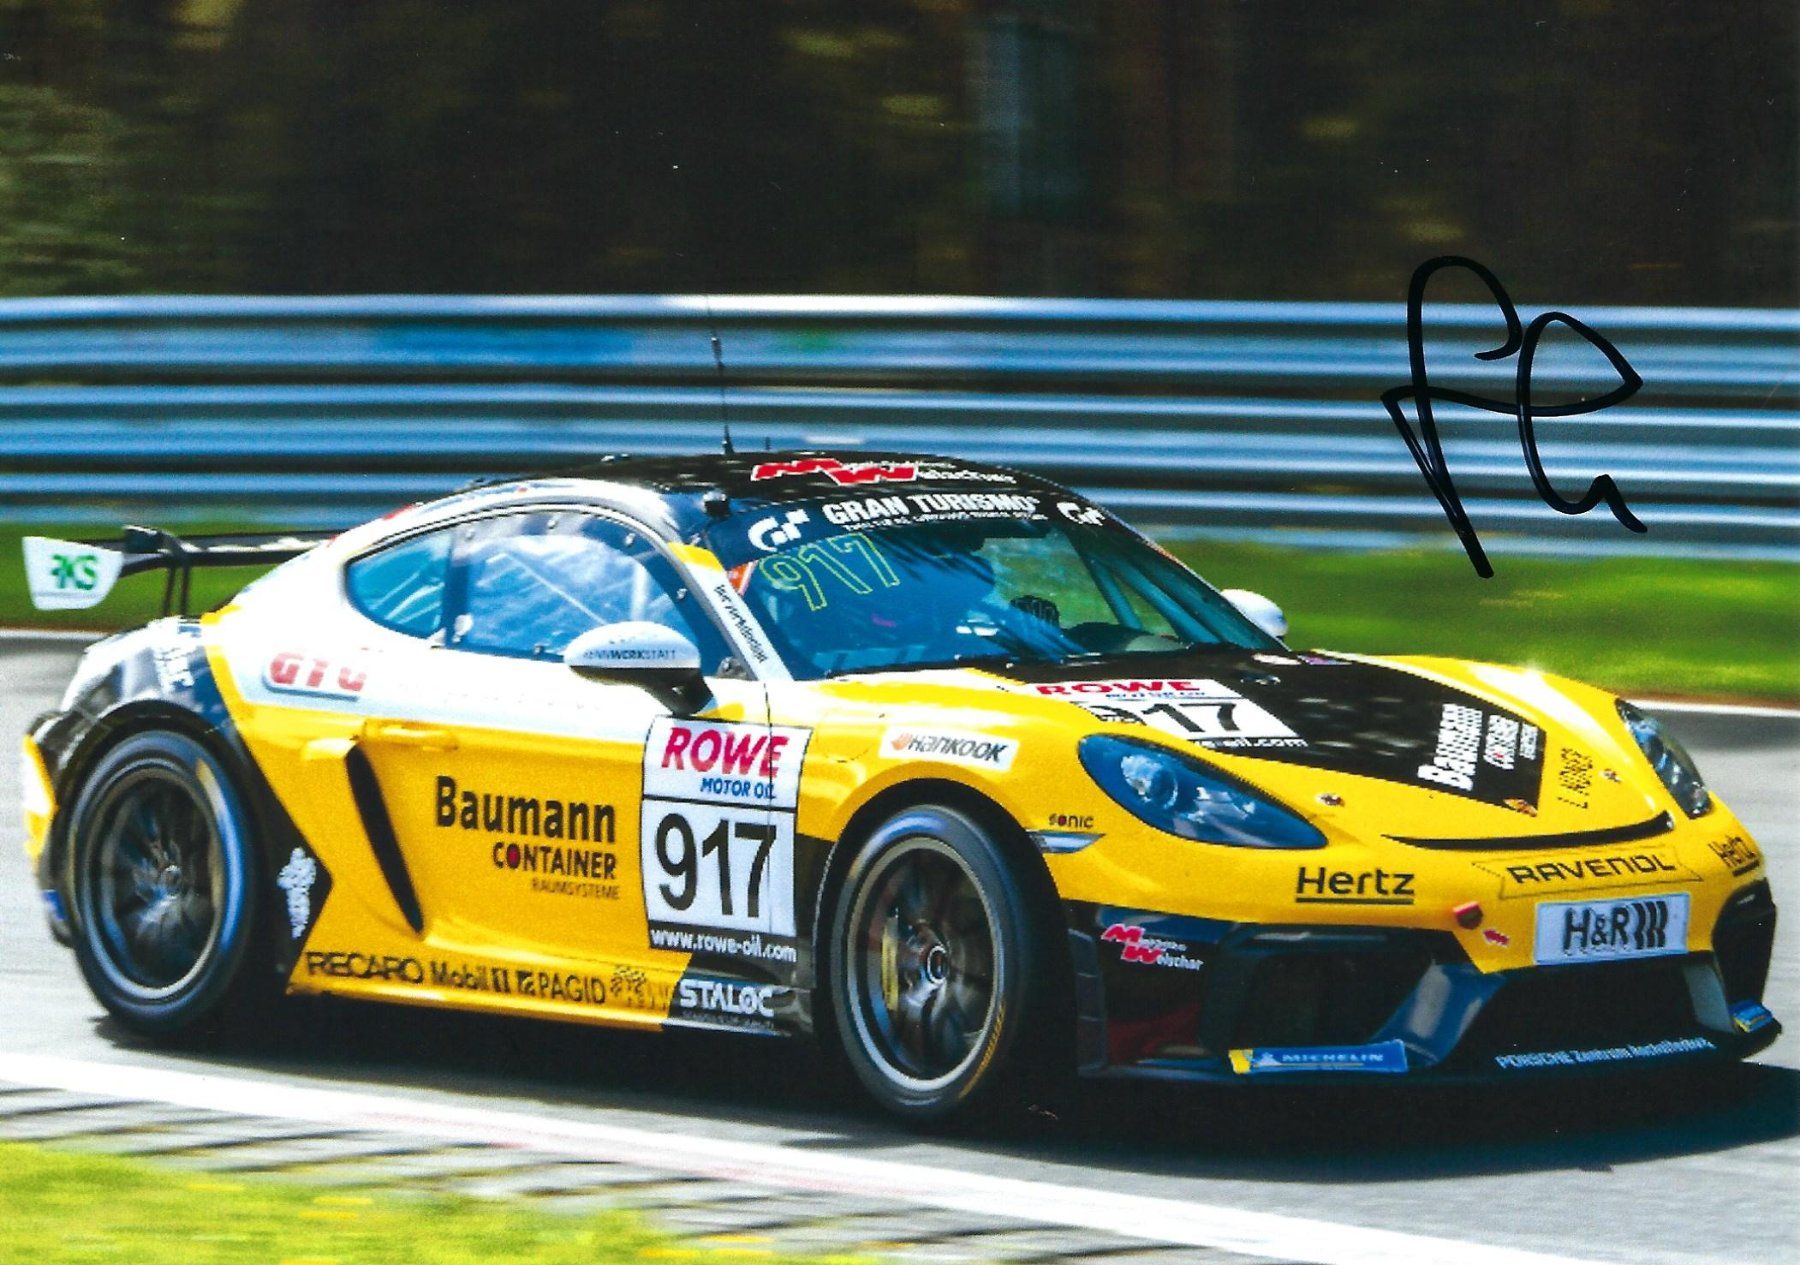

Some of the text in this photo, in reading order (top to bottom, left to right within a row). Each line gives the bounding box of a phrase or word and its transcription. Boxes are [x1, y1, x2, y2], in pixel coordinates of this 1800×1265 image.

[822, 495, 909, 524] GRAN
[908, 493, 1036, 513] TURISMO
[759, 532, 900, 612] 917
[1036, 681, 1201, 695] ROWE
[661, 727, 789, 779] ROWE
[701, 777, 777, 800] MOTOR OIL
[435, 775, 616, 843] Baumann
[492, 841, 616, 880] CONTAINER
[655, 813, 777, 918] 917
[1506, 853, 1678, 884] RAVENOL
[1297, 866, 1415, 896] Hertz
[1563, 905, 1630, 951] H&R
[651, 929, 797, 963] www.rowe-oil.com
[306, 950, 425, 984] RECARO
[430, 960, 489, 990] Mobil
[539, 973, 606, 1005] PAGID
[1281, 1053, 1384, 1063] MICHELIN
